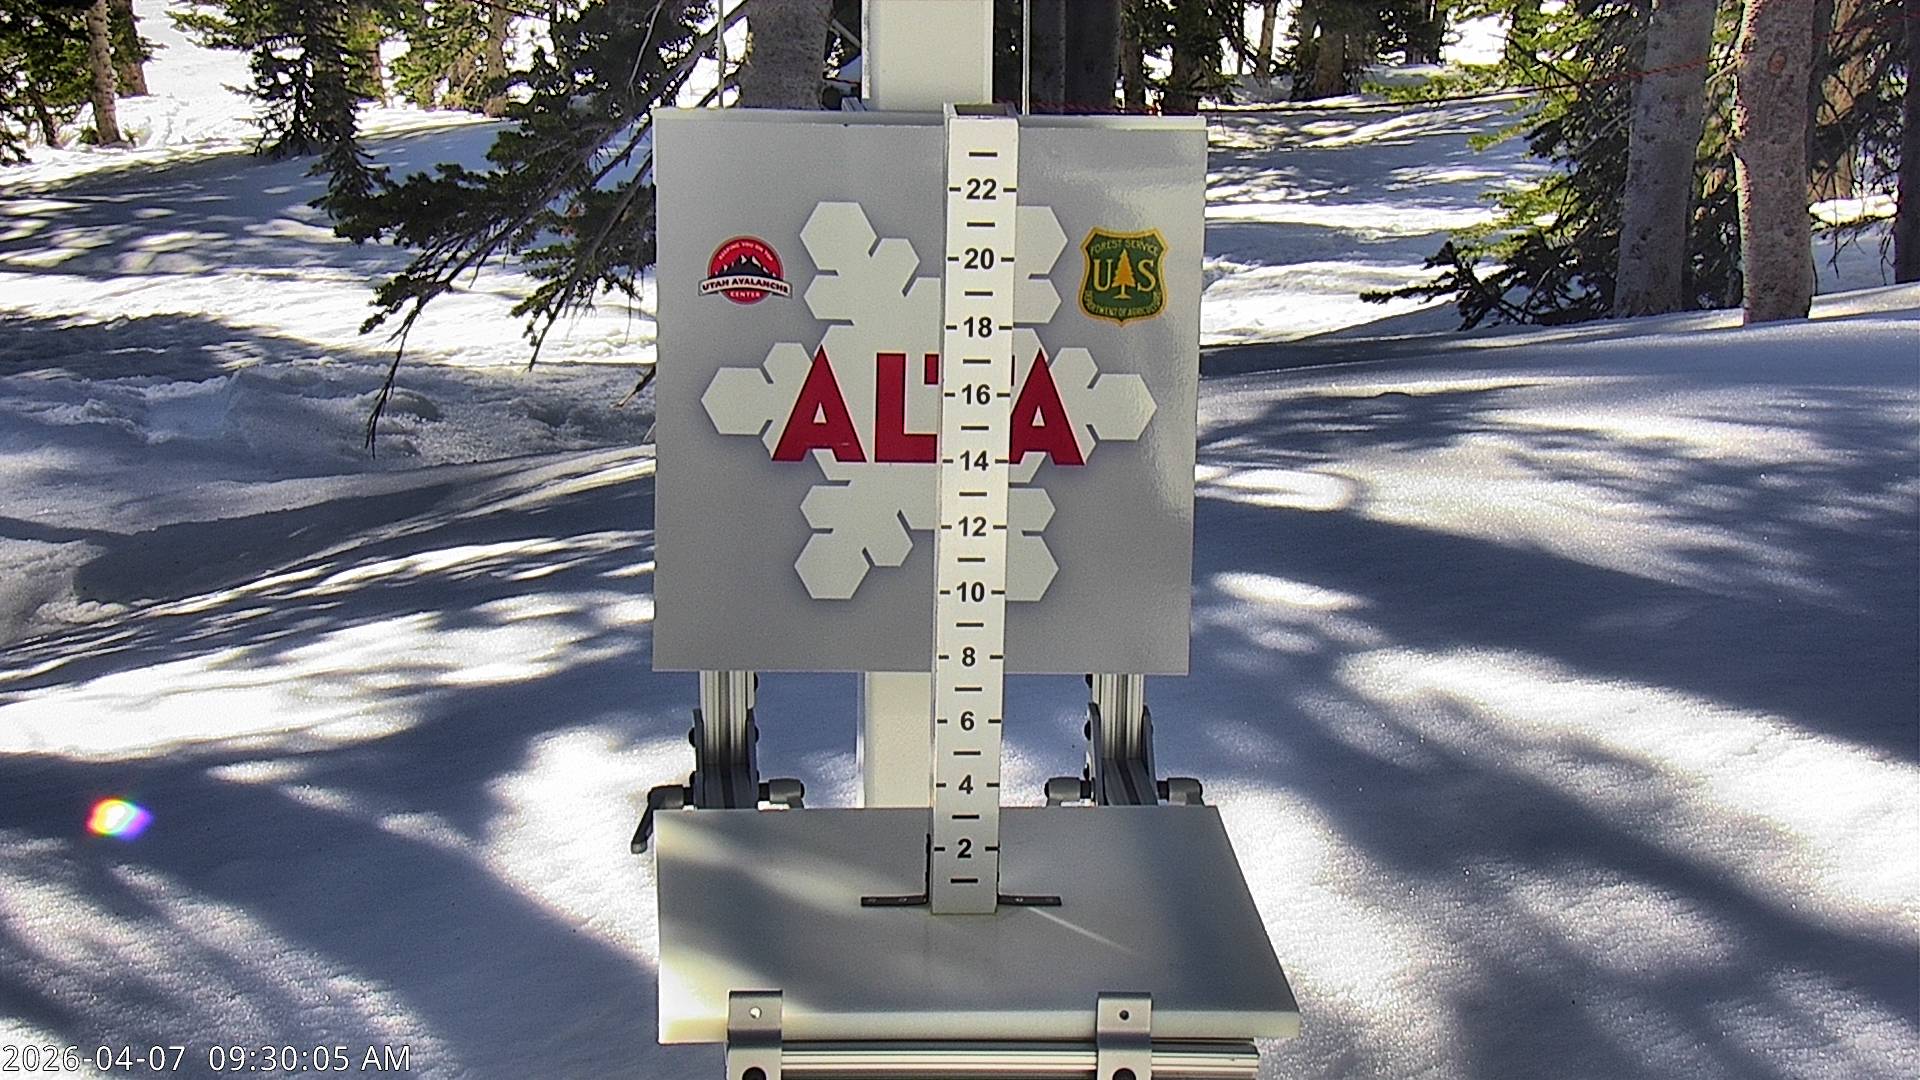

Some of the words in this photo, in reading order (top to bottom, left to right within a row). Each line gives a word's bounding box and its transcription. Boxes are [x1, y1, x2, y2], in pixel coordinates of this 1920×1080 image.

[967, 178, 996, 200] 22
[964, 248, 994, 269] 20
[1090, 240, 1121, 256] FOREST
[1125, 240, 1159, 257] SERVICE
[702, 278, 729, 291] UTAH
[731, 278, 788, 293] AVALANCHE
[729, 290, 761, 298] CENTER
[964, 317, 992, 338] 18
[961, 384, 990, 405] 16
[959, 450, 988, 471] 14
[958, 517, 987, 537] 12
[956, 582, 985, 602] 10
[961, 647, 976, 667] 8
[960, 711, 975, 731] 6
[958, 775, 974, 795] 4
[957, 838, 972, 859] 2
